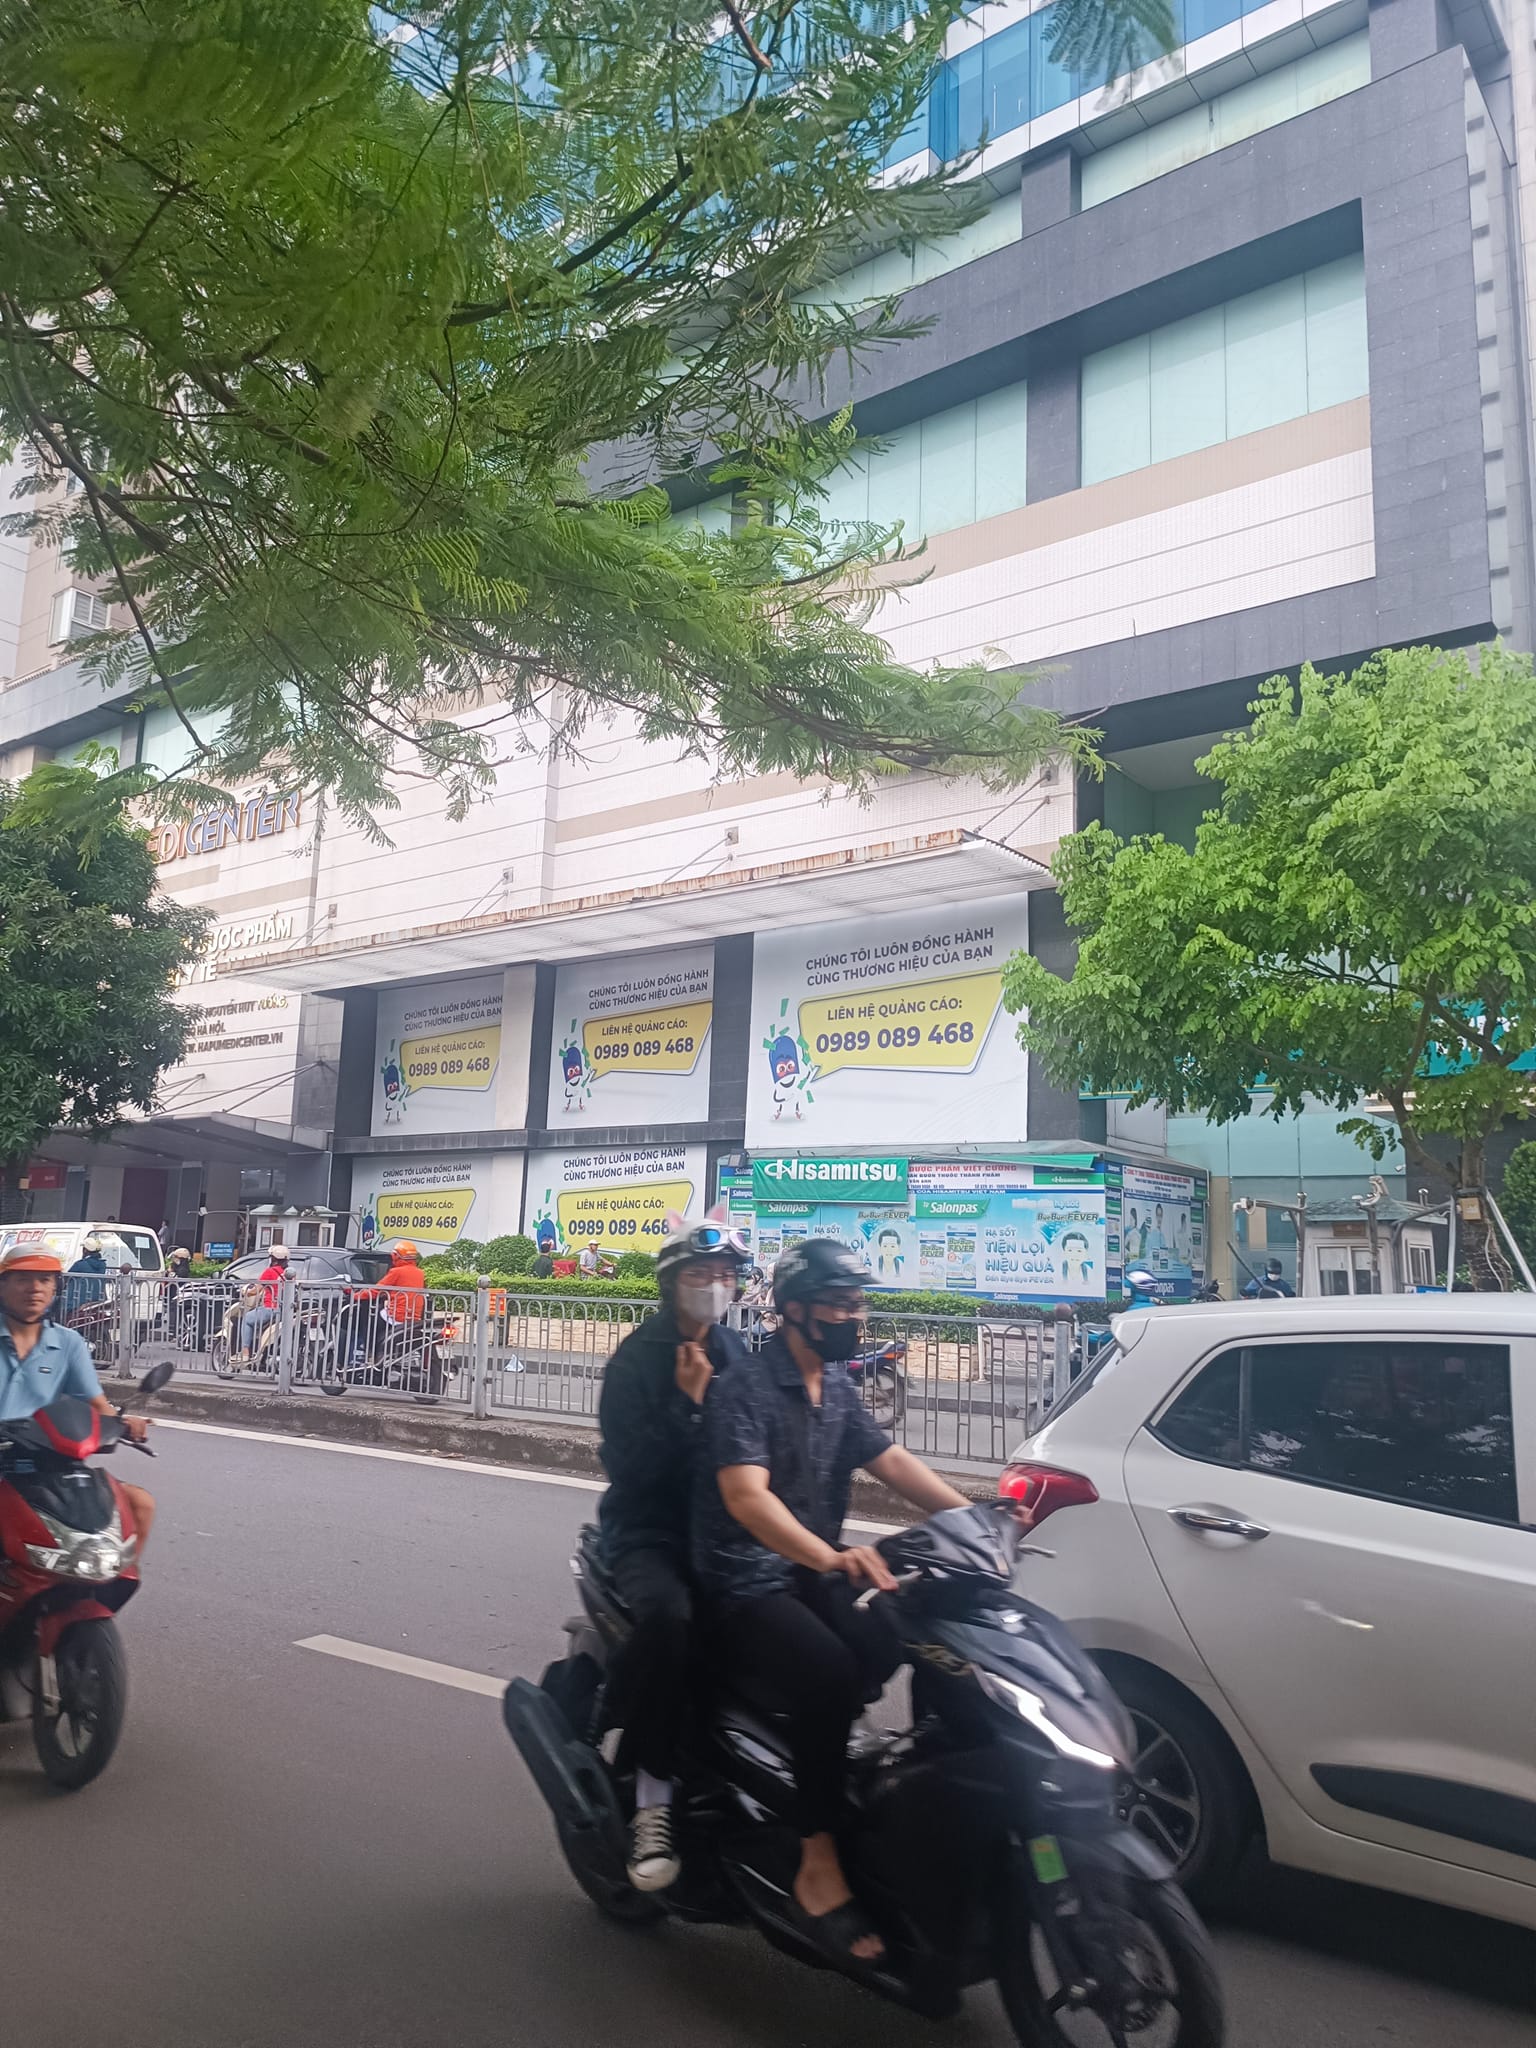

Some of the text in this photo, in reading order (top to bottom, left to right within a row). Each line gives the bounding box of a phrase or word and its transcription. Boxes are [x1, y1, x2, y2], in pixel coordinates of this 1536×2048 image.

[244, 908, 293, 946] PHẨM
[806, 954, 847, 970] CHÚNG
[851, 949, 870, 963] TÔI
[874, 942, 909, 959] LUÔN
[954, 927, 994, 944] HÀNH
[807, 945, 993, 986] CÙNG THƯƠNG HIỆU CỦA BẠN
[589, 986, 616, 998] CHÚNG
[618, 983, 631, 993] TÔI
[633, 979, 656, 991] LUÔN
[684, 969, 708, 981] HÀNH
[589, 982, 708, 1010] CÙNG THƯƠNG HIỆU CỦA BẠN
[827, 996, 962, 1021] LIÊN HỆ QUẢNG CÁO:
[602, 1018, 688, 1036] LIÊN HỆ QUẢNG CÁO:
[816, 1022, 974, 1053] 0989 089 468
[594, 1037, 694, 1060] 0989 089 468
[409, 1057, 490, 1077] 0989 089 468
[564, 1156, 591, 1168] CHÚNG
[593, 1154, 607, 1166] TÔI
[609, 1152, 632, 1164] LUÔN
[661, 1147, 686, 1158] HÀNH
[564, 1161, 685, 1181] CÙNG THƯƠNG HIỆU CỦA BẠN
[576, 1196, 664, 1212] LIÊN HỆ QUẢNG CÁO:
[768, 1202, 809, 1214] Salonpas
[930, 1202, 978, 1215] Salonpas
[383, 1216, 458, 1228] 0989 089 468
[569, 1219, 669, 1235] 0989 089 468
[985, 1226, 1016, 1238] HẠ SỐT
[985, 1239, 1017, 1256] TIỆN
[985, 1257, 1055, 1274] HIỆU QUẢ
